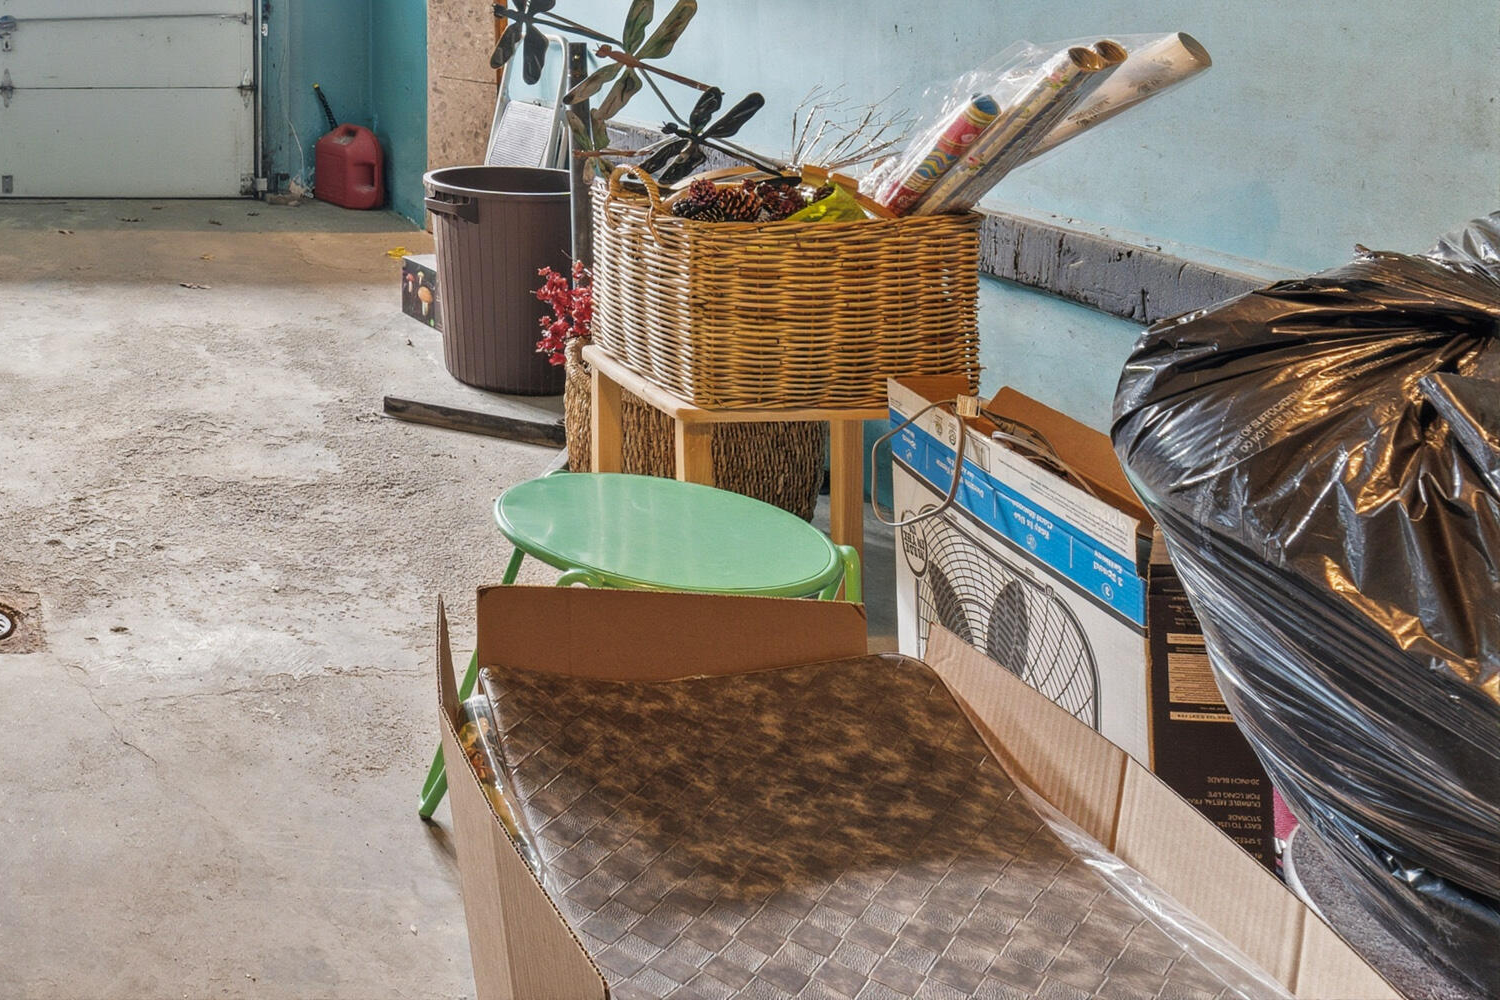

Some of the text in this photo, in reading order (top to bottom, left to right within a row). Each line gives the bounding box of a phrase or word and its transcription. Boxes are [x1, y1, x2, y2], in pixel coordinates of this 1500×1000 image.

[1240, 440, 1253, 453] DO
[1251, 429, 1268, 446] NOT
[905, 544, 925, 561] MADE
